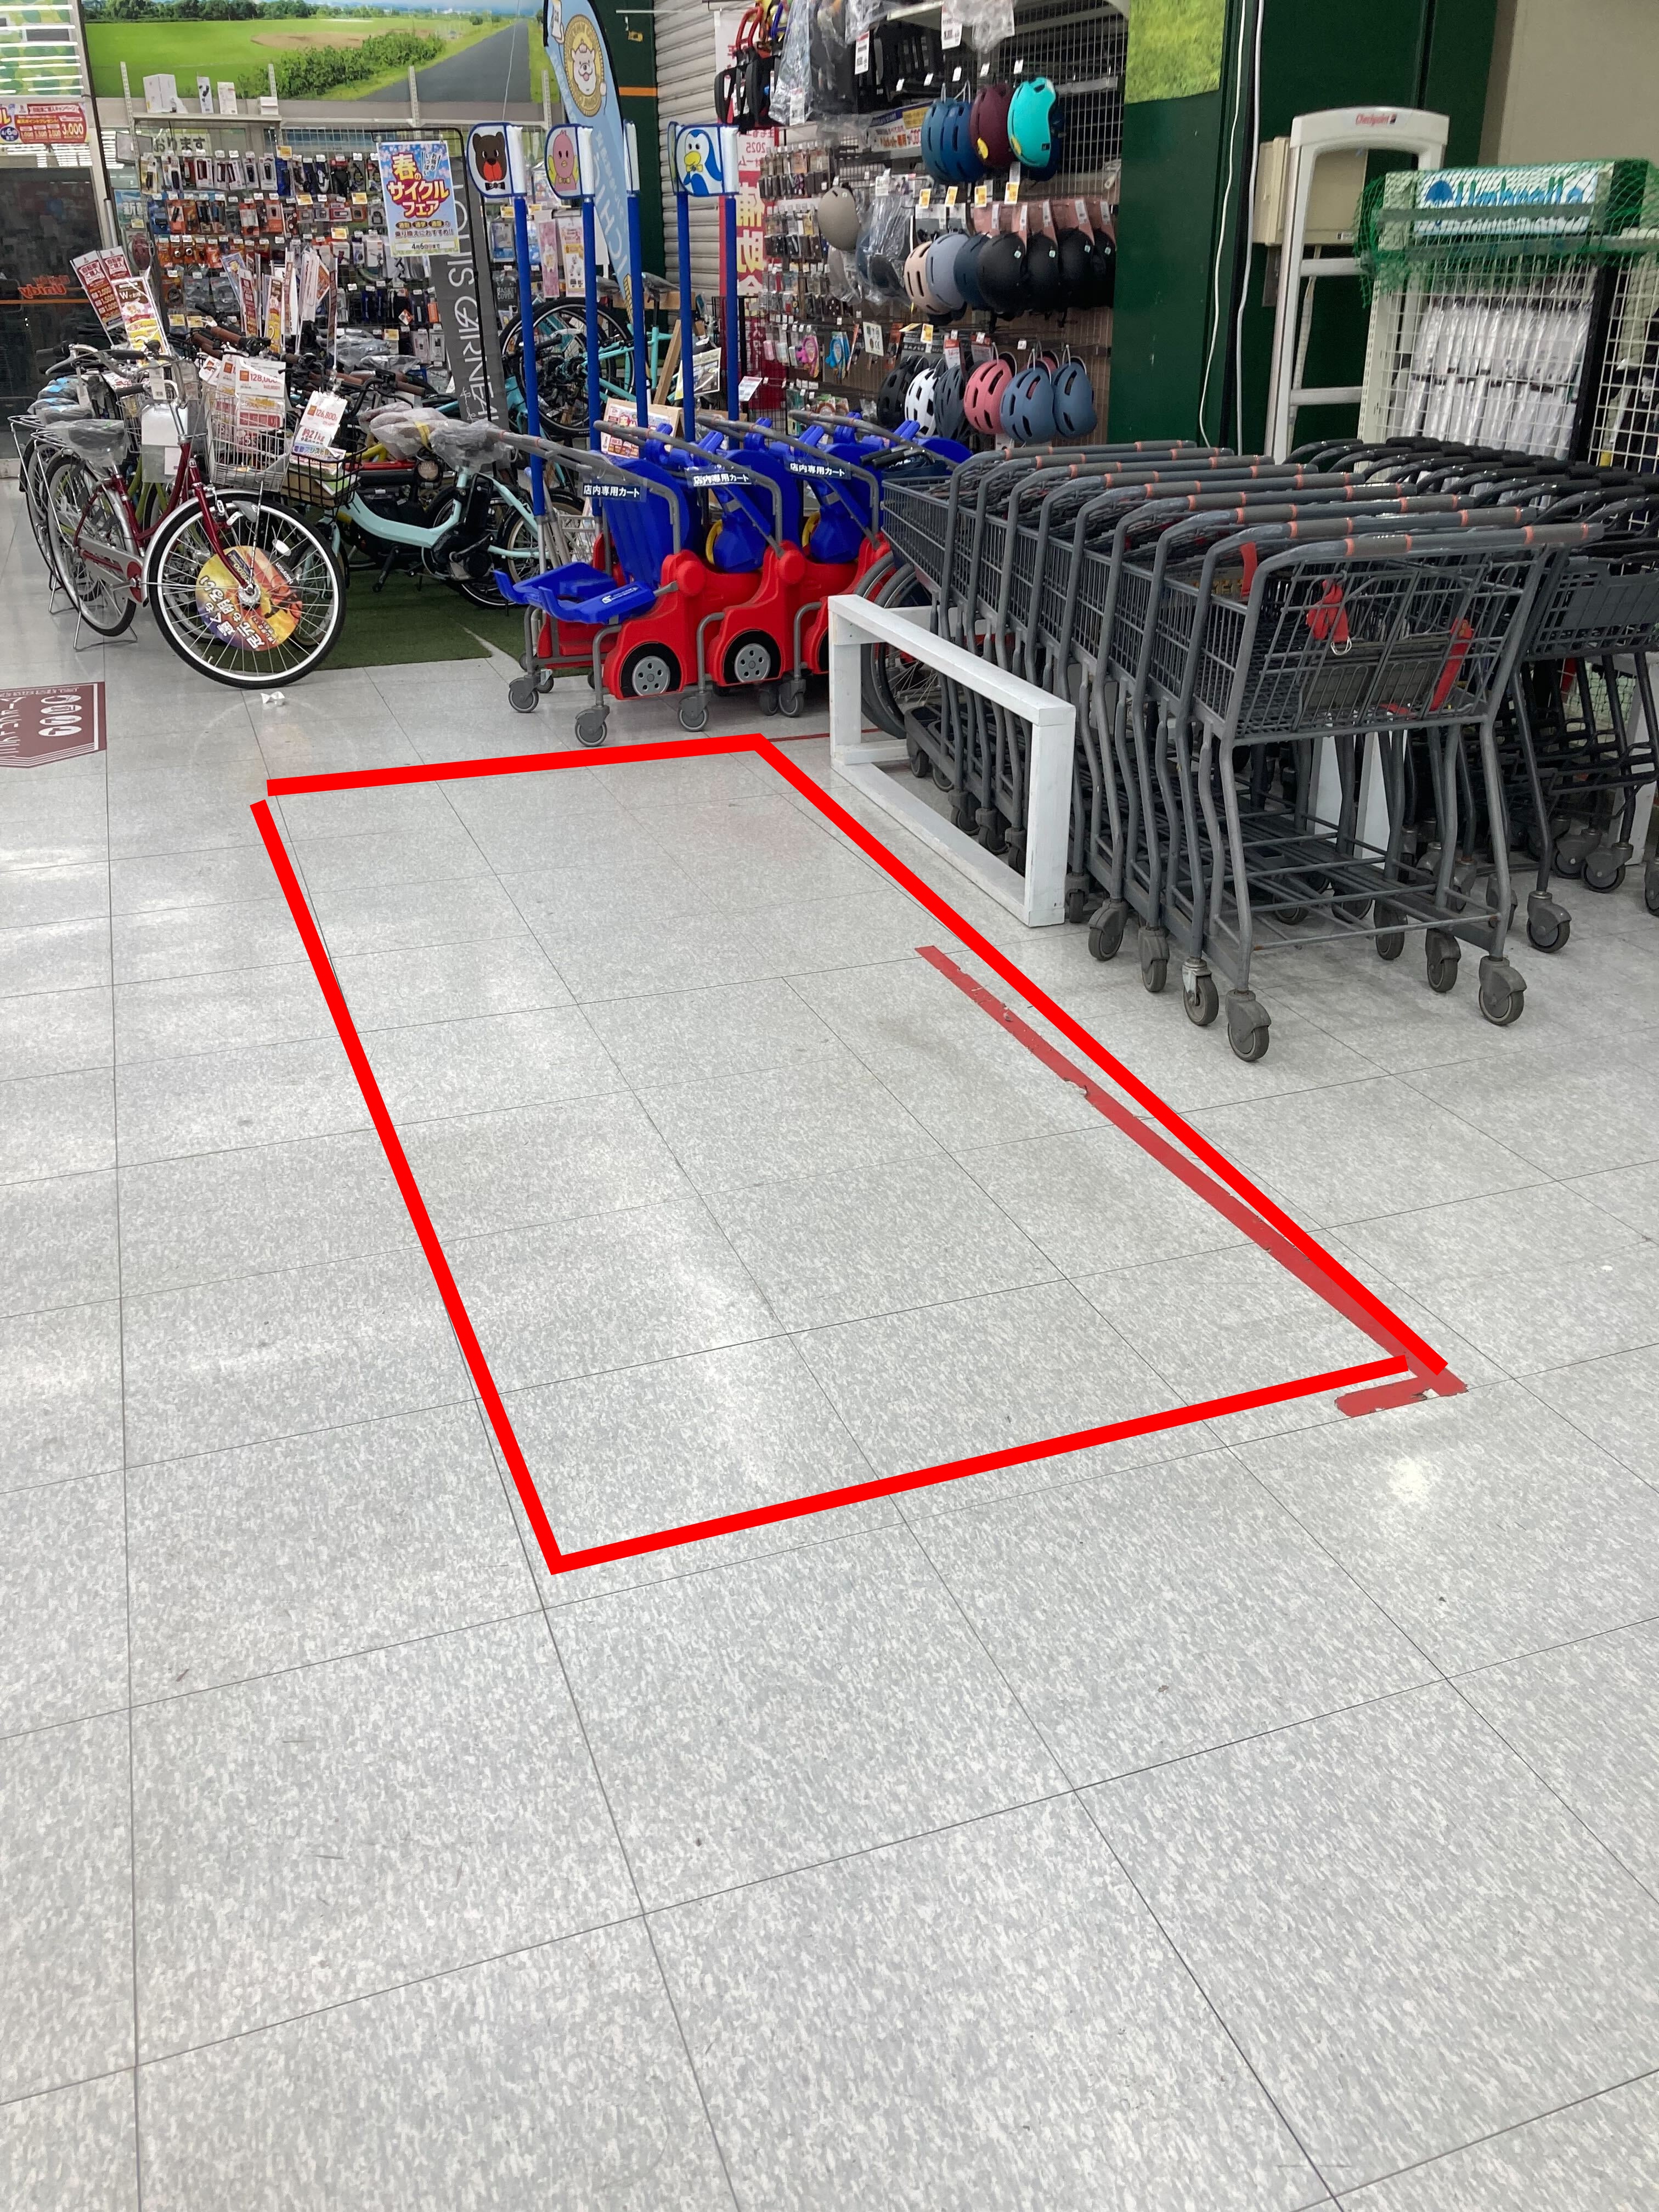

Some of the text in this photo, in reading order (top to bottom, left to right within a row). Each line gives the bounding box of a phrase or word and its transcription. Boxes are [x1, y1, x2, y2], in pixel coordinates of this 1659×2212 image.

[61, 123, 84, 135] 3,000
[392, 154, 422, 180] 春の
[387, 181, 449, 201] サイクル
[402, 200, 439, 217] フェア
[454, 296, 499, 420] GARNEA
[693, 473, 749, 486] 店内専用カート
[790, 463, 845, 477] 店内専用カート
[583, 485, 640, 498] 店内専用カート
[275, 562, 294, 585] Hapyson
[199, 575, 265, 650] 足元も明るい
[205, 602, 235, 636] 遠くも
